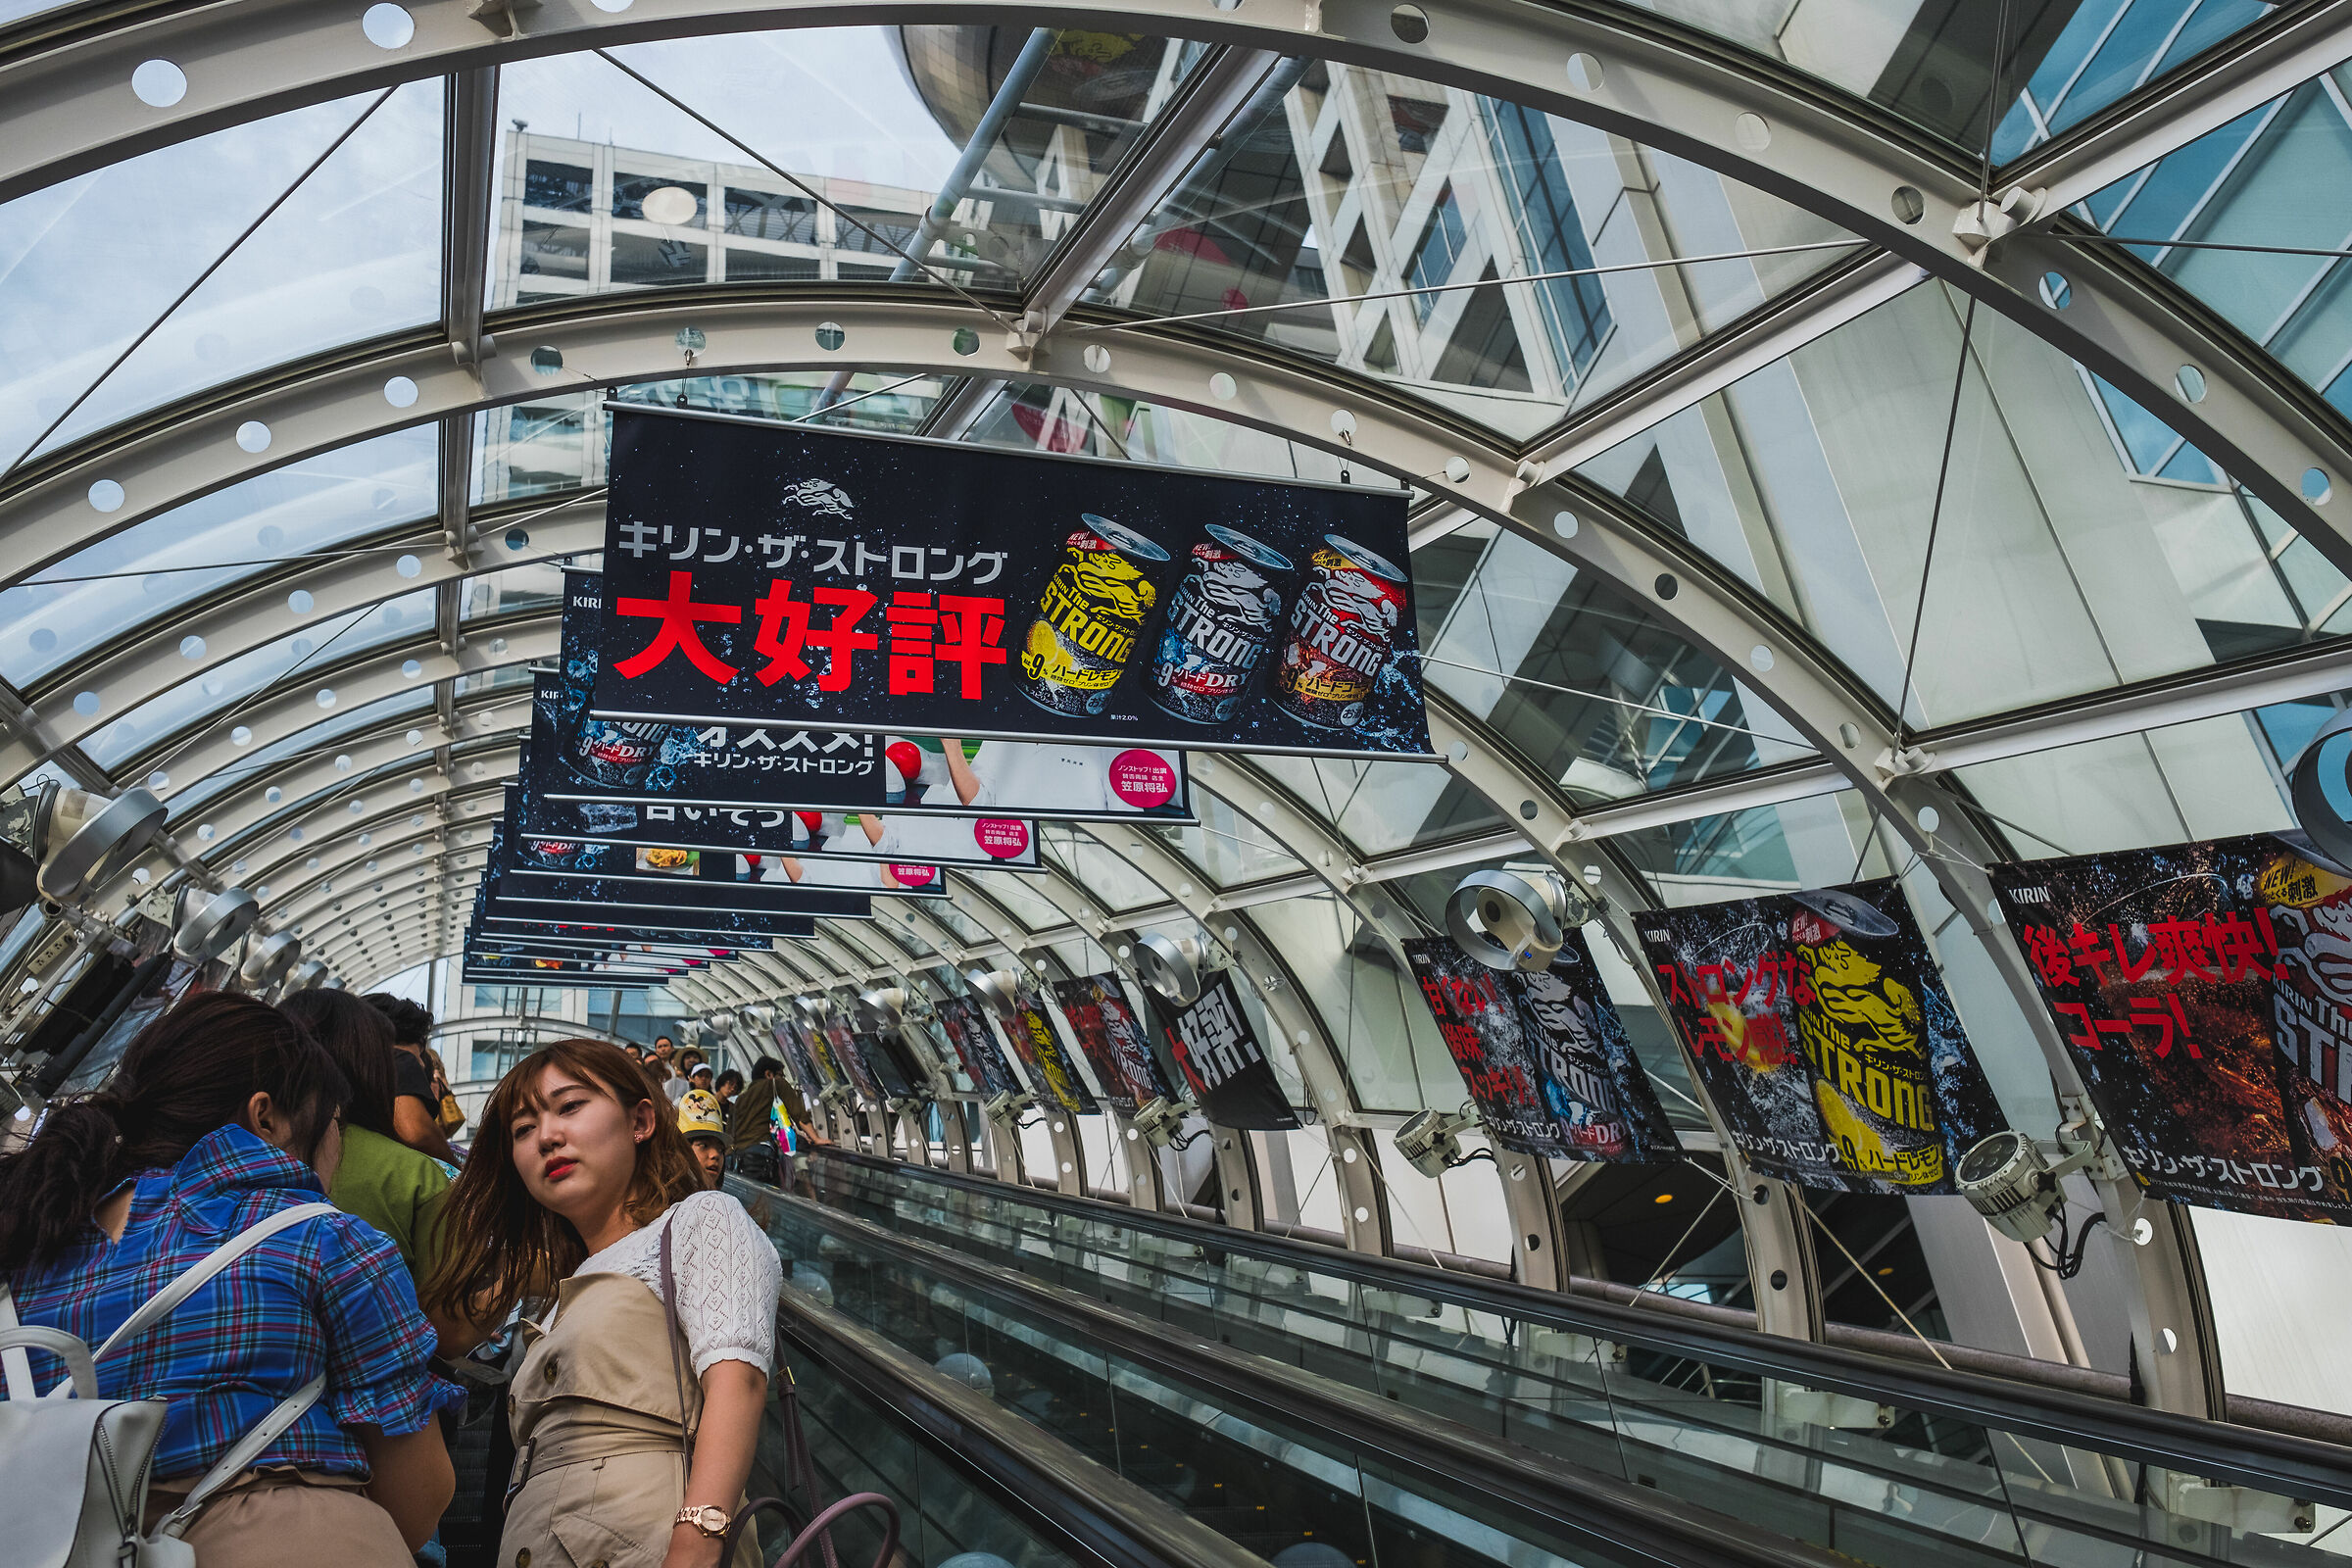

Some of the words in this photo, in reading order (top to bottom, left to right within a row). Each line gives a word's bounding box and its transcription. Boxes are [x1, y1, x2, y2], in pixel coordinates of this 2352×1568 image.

[618, 520, 1008, 585] キリン・ザ・ストロング
[572, 596, 602, 609] KIRI
[1054, 571, 1069, 595] KIRIN
[1068, 586, 1090, 611] The
[1194, 595, 1216, 618] The
[1317, 602, 1340, 624] The
[612, 570, 1006, 701] 大好評
[1052, 663, 1121, 682] ハードレモン
[693, 751, 875, 776] キリン・ザ・ストロング
[2263, 859, 2297, 891] NEW!
[2008, 886, 2051, 904] KIRIN
[1644, 929, 1671, 942] KIRIN
[2023, 906, 2290, 988] 後キレ爽快!
[1657, 951, 1817, 1008] ストロングな
[2273, 969, 2314, 1017] KIRIN
[1820, 1013, 1850, 1051] The
[2052, 993, 2204, 1060] コーラ!
[2122, 1145, 2325, 1192] キリン・ザ・ストロング
